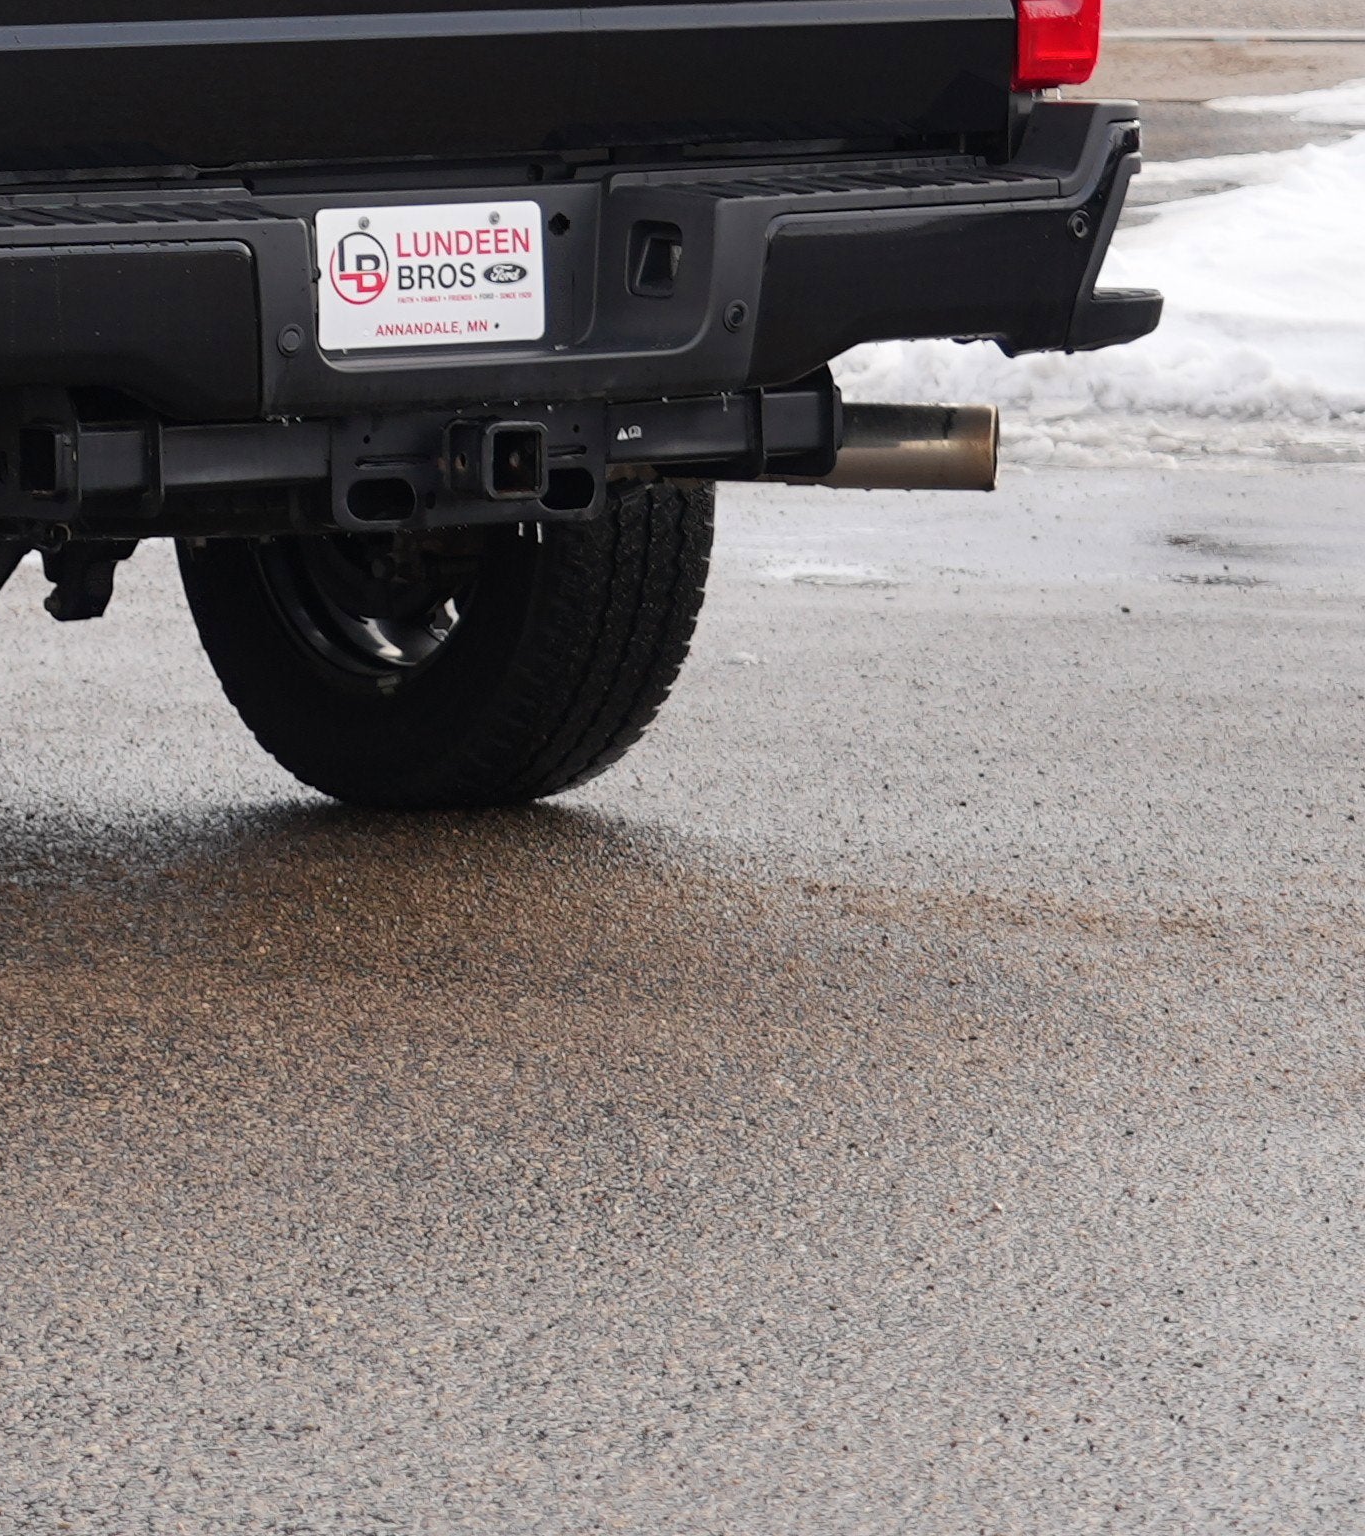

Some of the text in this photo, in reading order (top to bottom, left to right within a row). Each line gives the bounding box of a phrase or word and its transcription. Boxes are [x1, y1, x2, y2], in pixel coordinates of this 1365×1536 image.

[396, 228, 530, 258] LUNDEEN
[398, 263, 476, 290] BROS
[489, 264, 521, 282] Ford
[375, 320, 488, 337] ANNANDALE, MN
